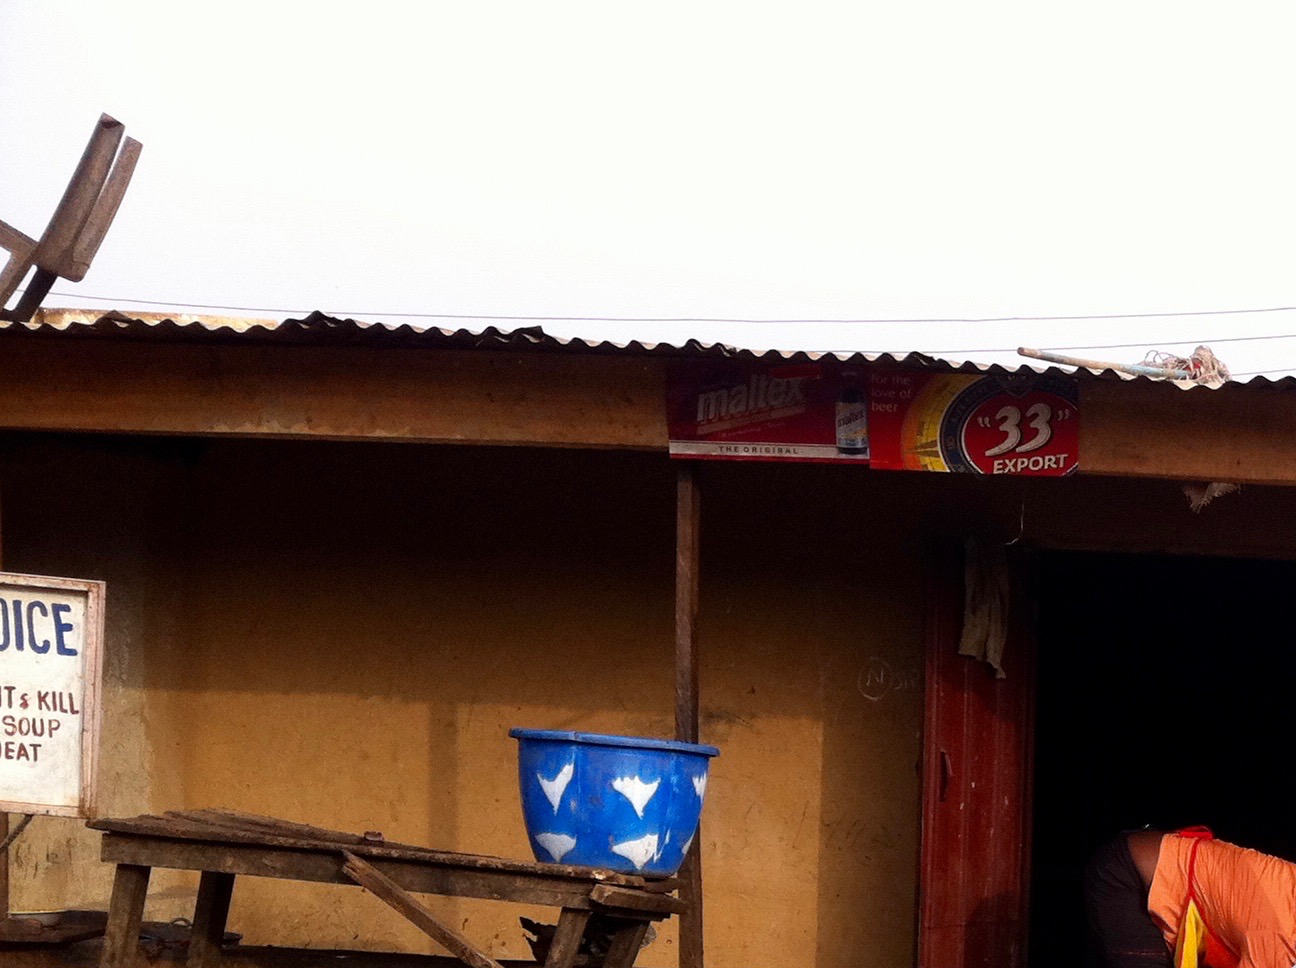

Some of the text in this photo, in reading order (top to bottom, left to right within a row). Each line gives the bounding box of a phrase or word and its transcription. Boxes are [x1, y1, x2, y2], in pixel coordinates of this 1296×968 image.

[696, 373, 806, 422] maltex
[871, 401, 898, 412] beer
[718, 445, 739, 454] THE
[993, 453, 1070, 474] EXPORT
[37, 690, 79, 715] KILL
[3, 715, 61, 738] SOUP
